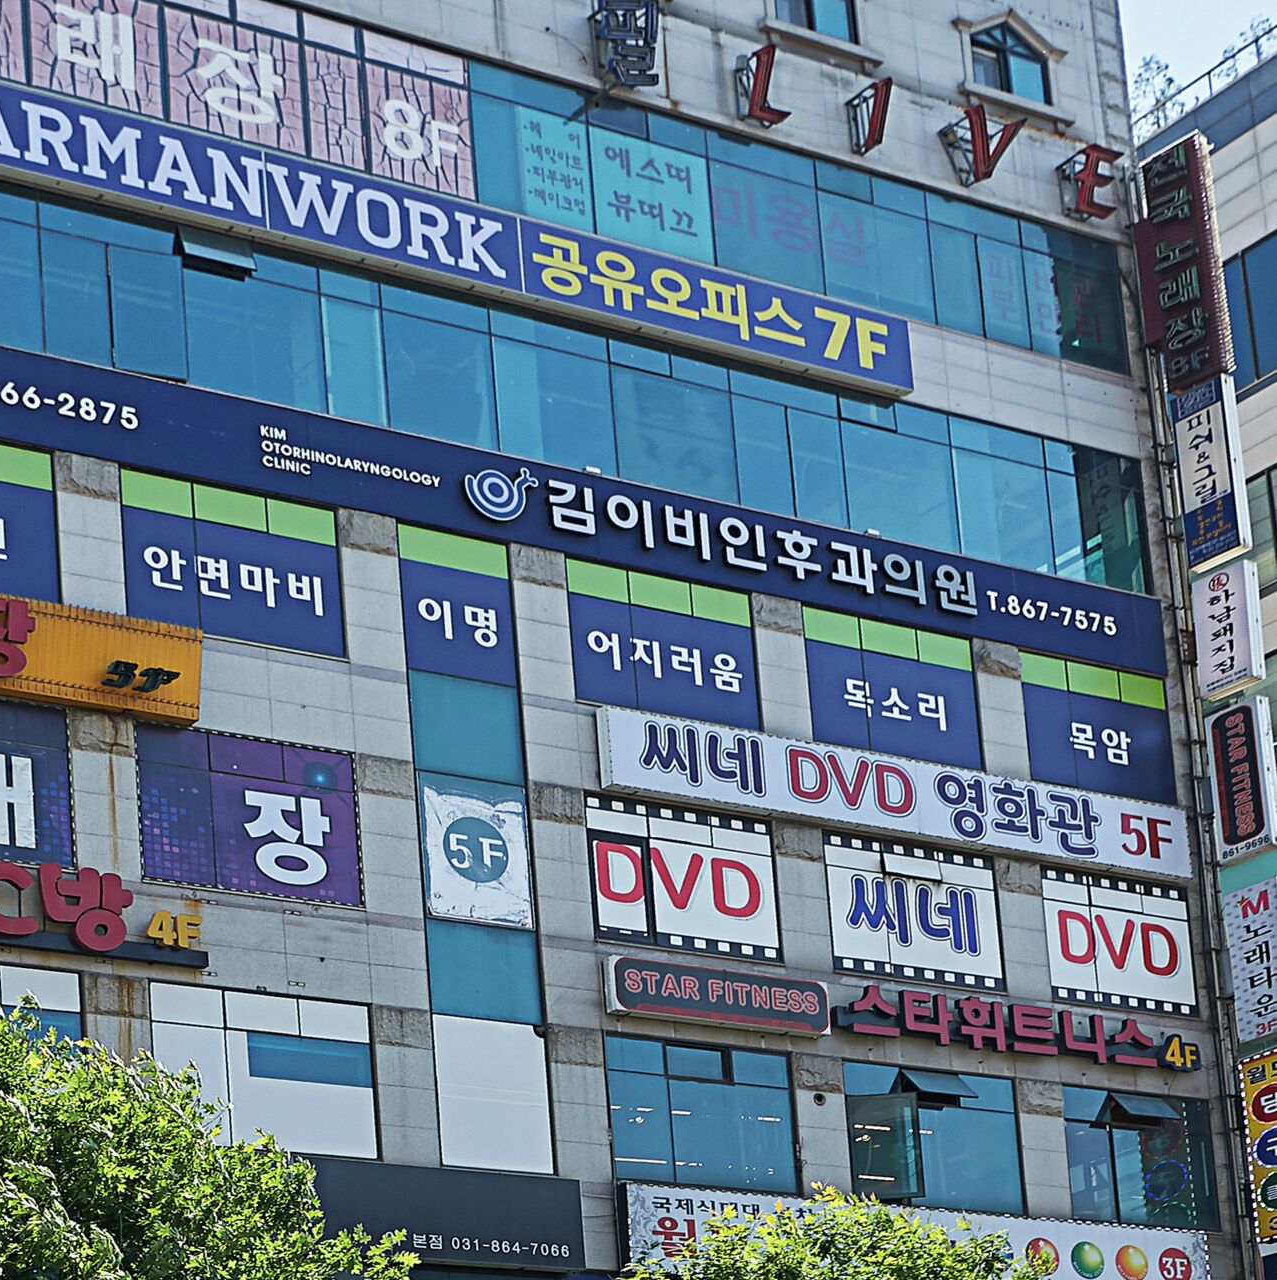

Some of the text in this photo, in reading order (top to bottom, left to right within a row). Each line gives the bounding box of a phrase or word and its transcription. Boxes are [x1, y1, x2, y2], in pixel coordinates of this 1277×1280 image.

[382, 97, 462, 168] 8F
[734, 43, 1125, 221] LIVE
[531, 230, 807, 348] 공유오피스
[813, 305, 890, 370] 7F
[259, 424, 287, 441] KIM
[260, 440, 442, 489] OTORHINOLARYNGOLOGY
[261, 455, 312, 476] CLINIC
[142, 544, 324, 617] 안면마비
[547, 477, 979, 617] 김이비인후과의원
[985, 589, 1118, 637] T.867-7575
[417, 596, 500, 649] 이명
[1206, 588, 1237, 675] 하남돼지집
[585, 629, 744, 694] 어지러움
[1068, 721, 1133, 767] 목암
[1224, 712, 1249, 765] STAR
[639, 720, 1173, 860] 씨네 DVD 영화관 5F
[1230, 763, 1258, 840] FITNESS
[447, 832, 506, 870] 5F
[596, 839, 762, 919] DVD
[146, 909, 203, 950] 4F
[847, 874, 981, 958] 씨네
[1056, 908, 1181, 978] DVD
[623, 966, 820, 1016] STAR FITNESS
[851, 984, 1199, 1069] 스타휘트니스 4F
[412, 1233, 444, 1250] 본점
[451, 1236, 571, 1259] 031-864-7066
[1161, 1257, 1189, 1280] 3F
